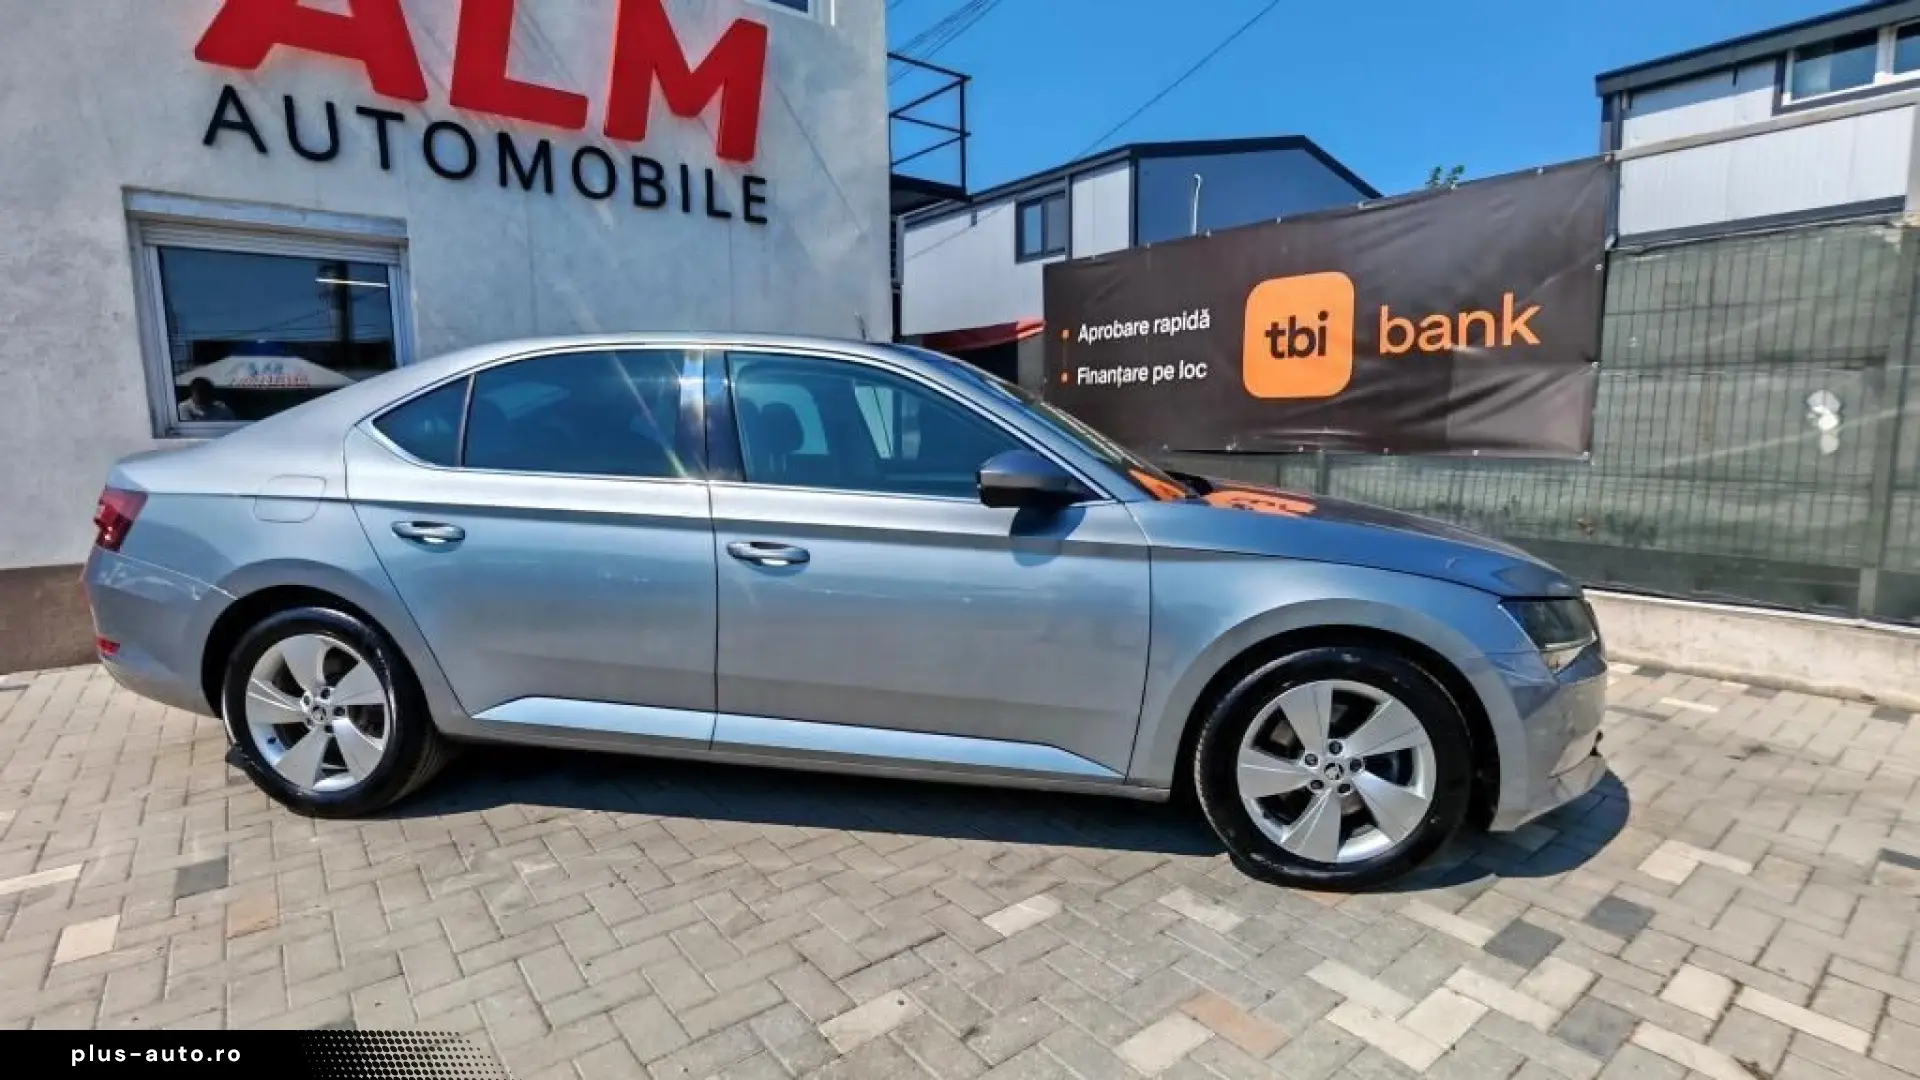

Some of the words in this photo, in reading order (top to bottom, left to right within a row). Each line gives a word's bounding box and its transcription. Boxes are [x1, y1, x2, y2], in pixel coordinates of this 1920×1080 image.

[195, 0, 769, 162] ALM
[202, 85, 769, 225] AUTOMOBILE
[1077, 319, 1150, 346] Aprobare
[1153, 308, 1211, 337] rapidă
[1264, 310, 1329, 359] tbi
[1378, 292, 1541, 355] bank
[1152, 364, 1175, 385] pe
[1178, 359, 1208, 380] loc
